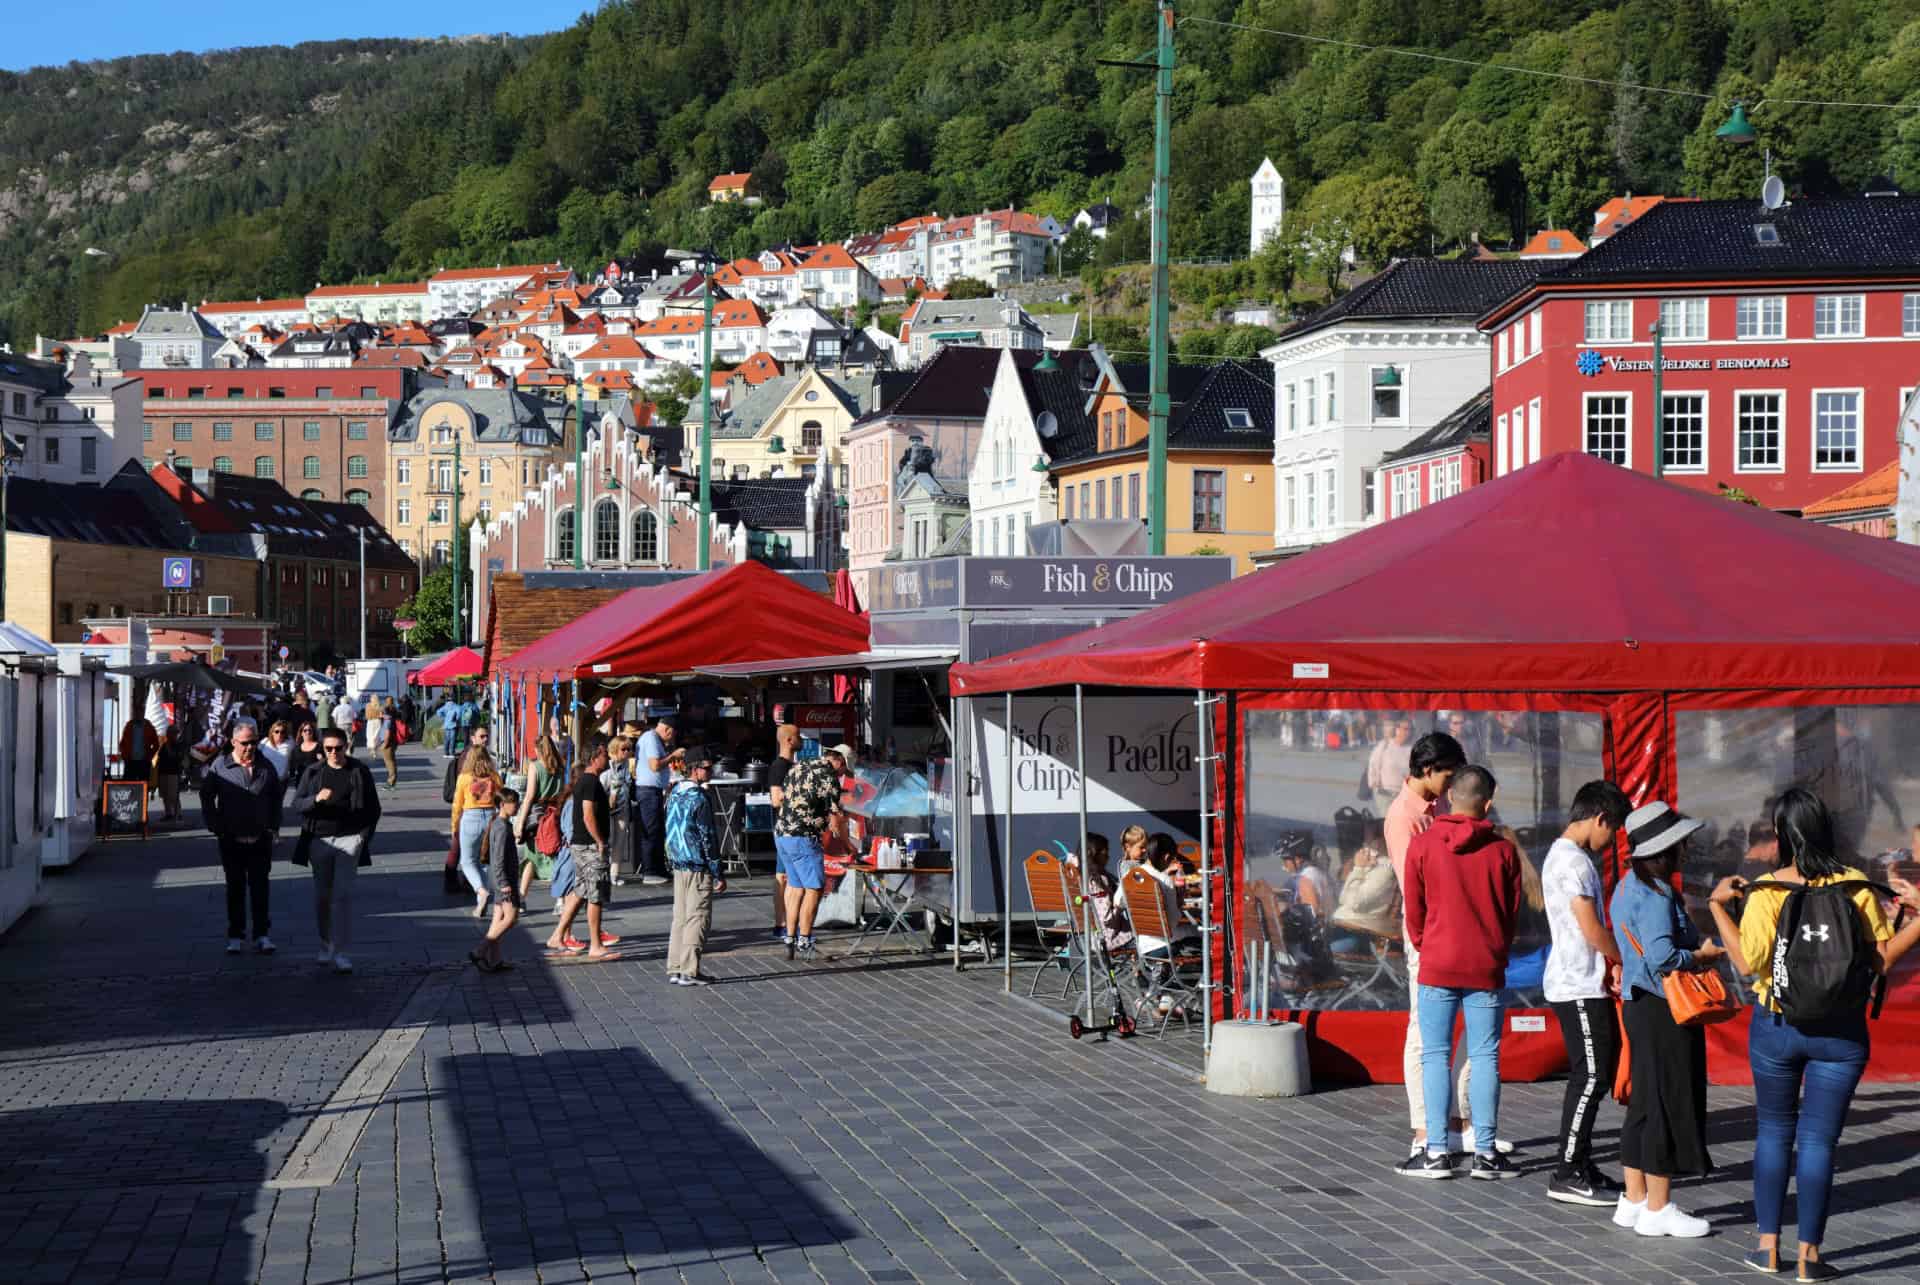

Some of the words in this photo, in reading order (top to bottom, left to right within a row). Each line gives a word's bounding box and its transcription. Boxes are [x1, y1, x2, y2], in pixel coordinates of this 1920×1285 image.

[1607, 356, 1711, 371] VESTENJELDSKE
[1716, 358, 1770, 369] EIENDOM
[1771, 357, 1789, 369] AS
[1042, 563, 1087, 597] Fish
[1092, 563, 1110, 592] &
[1115, 563, 1173, 600] Chips
[1107, 724, 1192, 780] Paella
[1016, 759, 1081, 800] Chips
